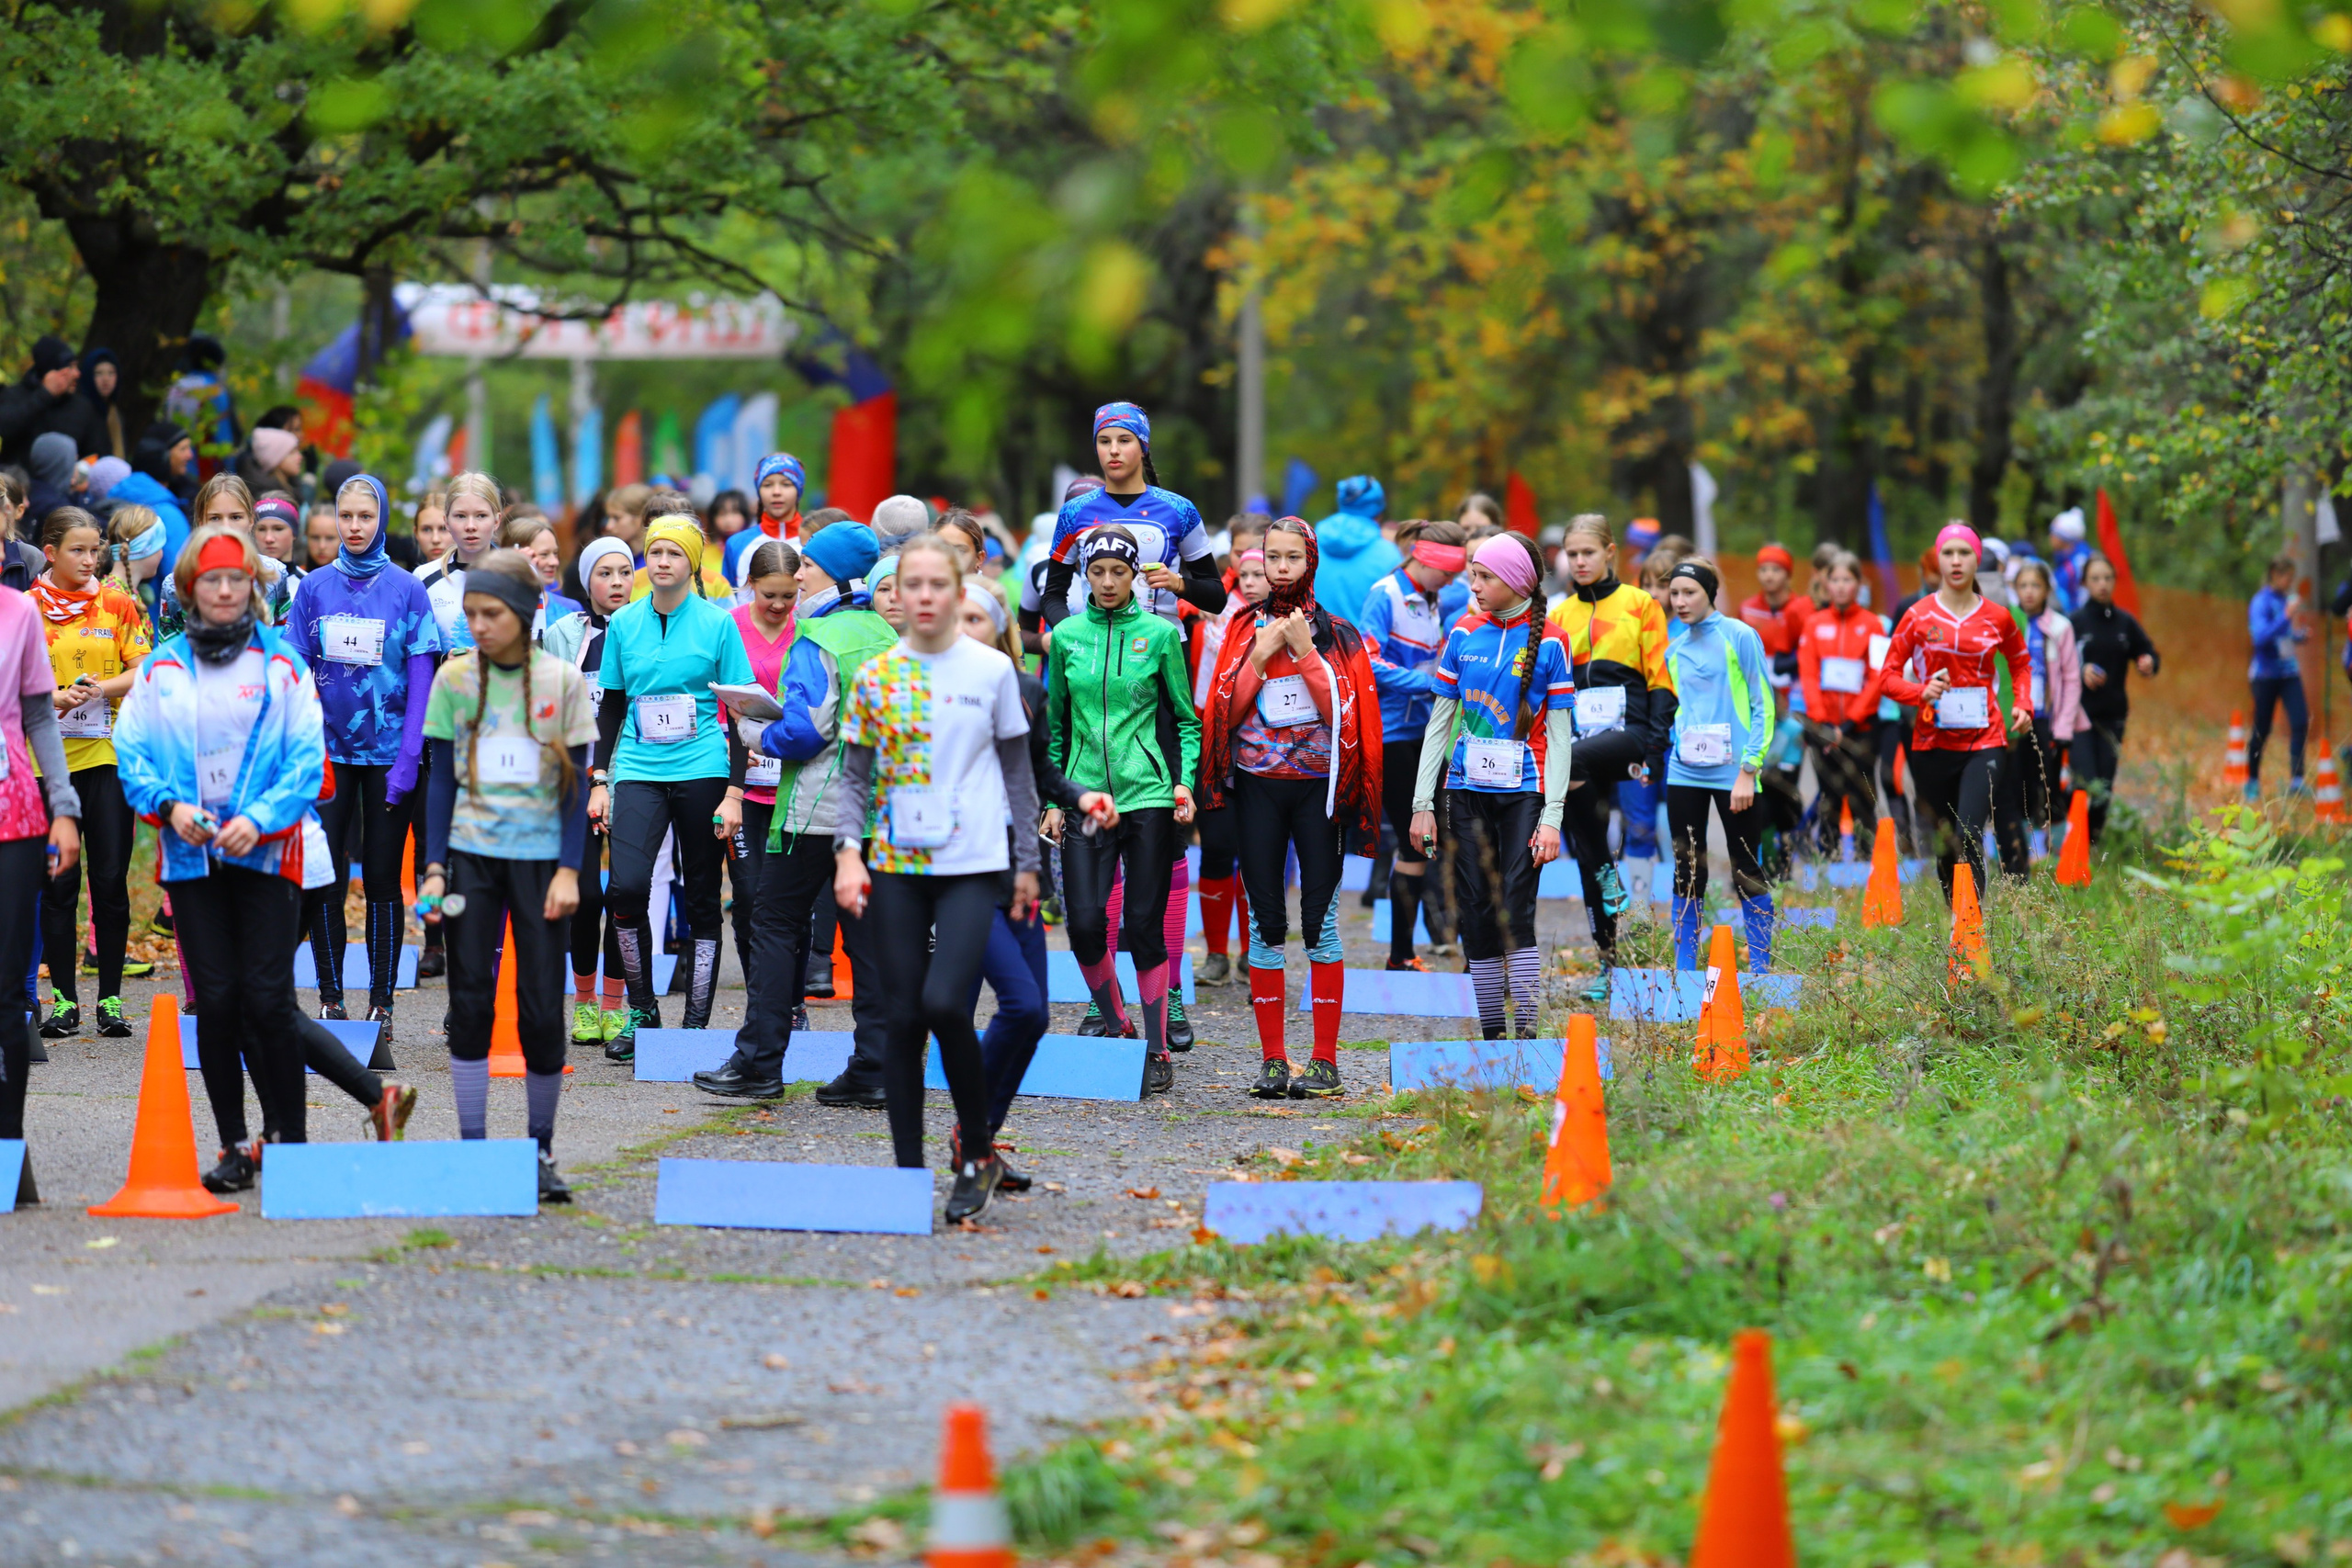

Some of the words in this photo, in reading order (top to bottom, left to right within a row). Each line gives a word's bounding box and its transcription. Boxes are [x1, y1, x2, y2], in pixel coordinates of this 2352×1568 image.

[343, 636, 357, 647] 44
[590, 691, 602, 704] 42
[1283, 694, 1297, 705] 27
[1465, 688, 1511, 726] ВОРОНЕЖ
[1590, 704, 1602, 713] 63
[73, 710, 87, 721] 46
[657, 714, 670, 726] 31
[1694, 742, 1707, 752] 49
[501, 753, 514, 768] 11
[760, 758, 775, 770] 40
[1481, 757, 1496, 770] 26
[210, 768, 227, 784] 15
[914, 809, 922, 822] 4
